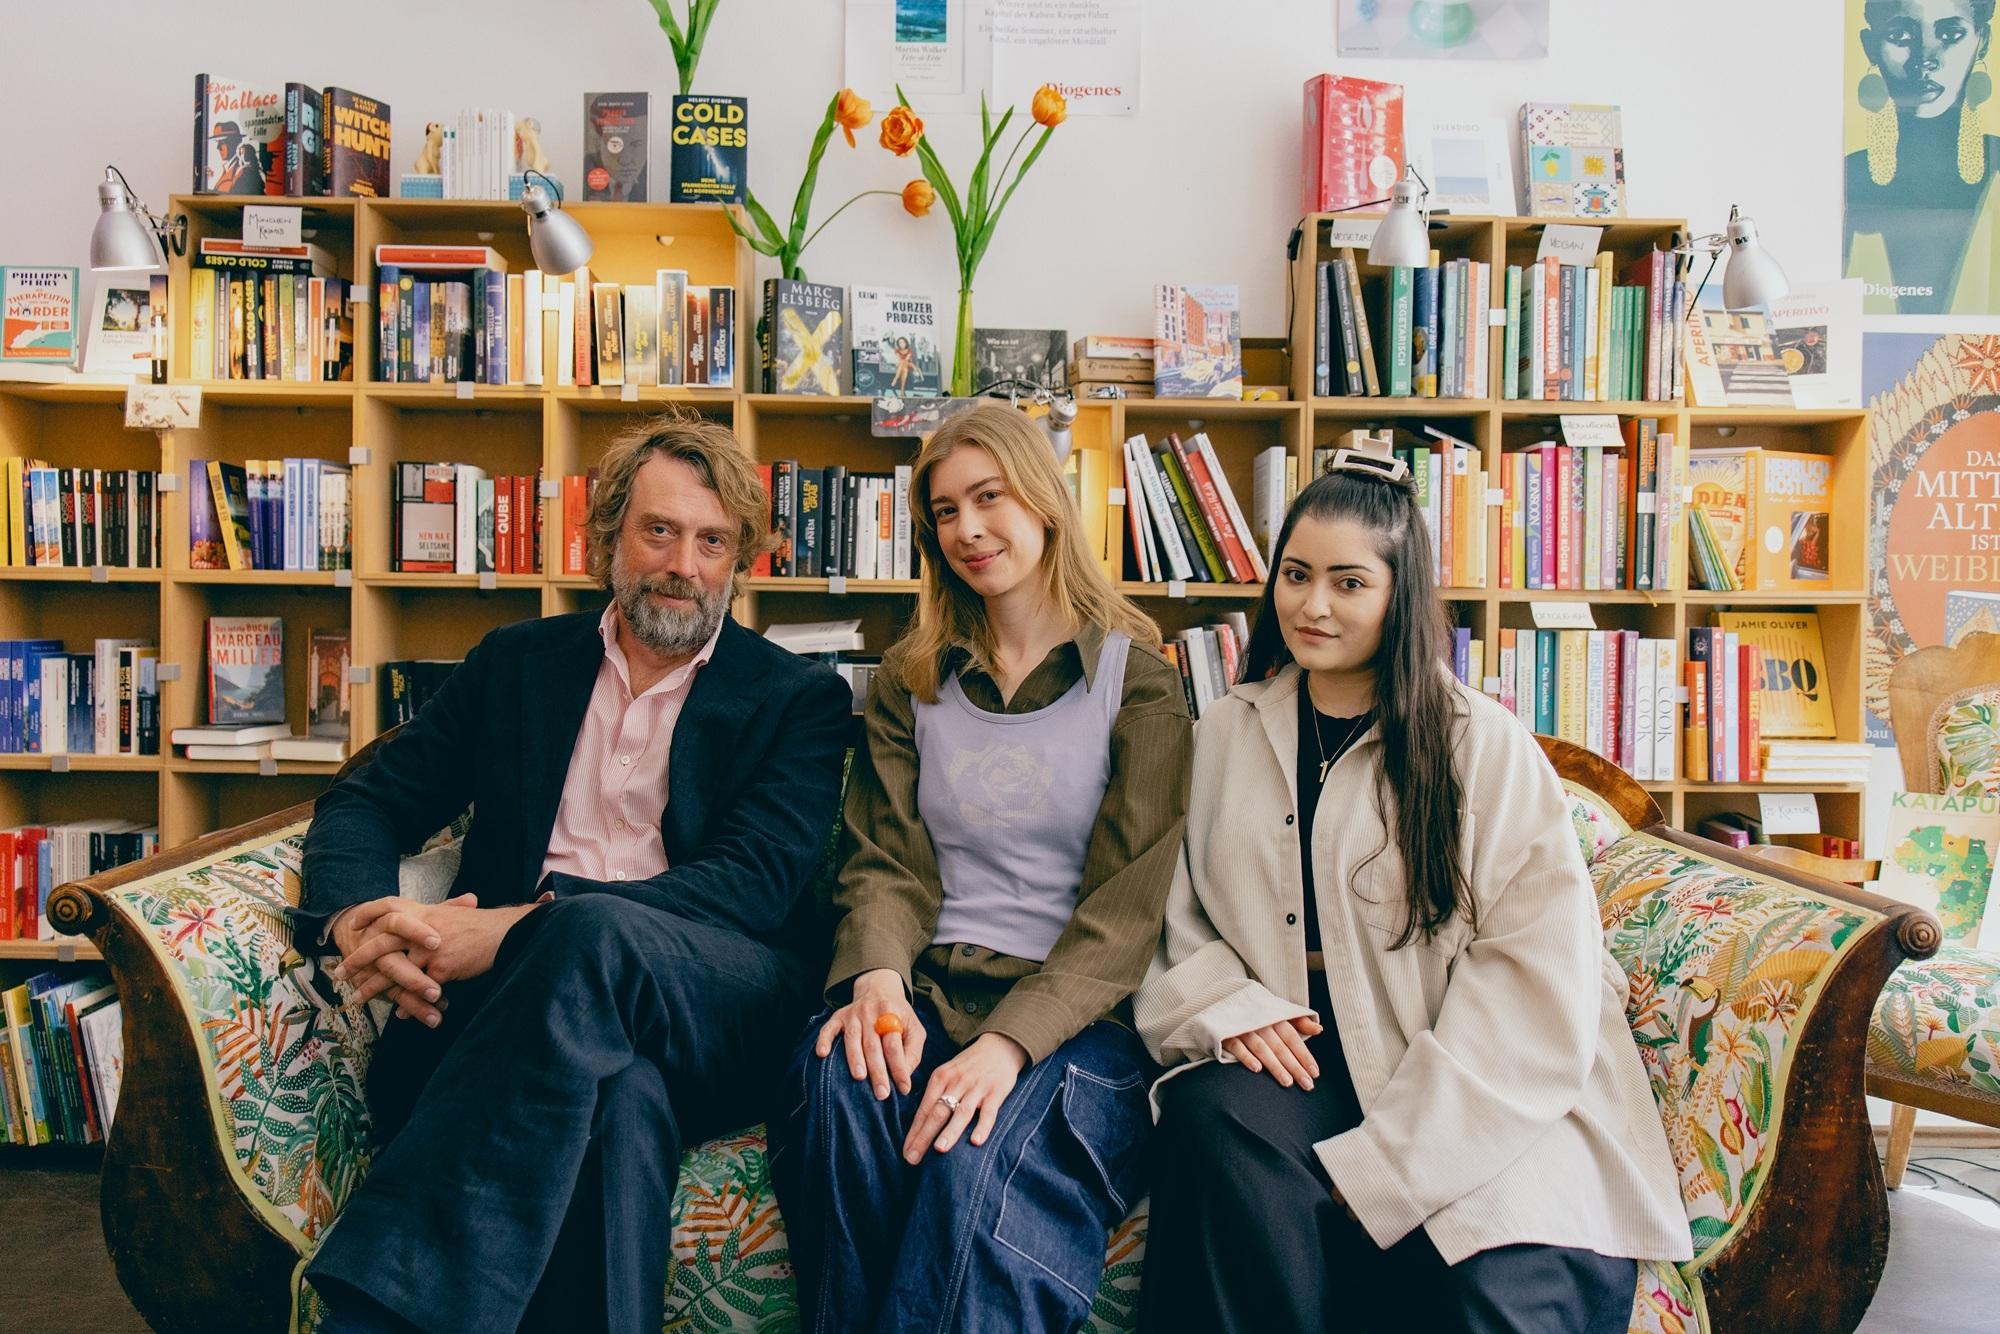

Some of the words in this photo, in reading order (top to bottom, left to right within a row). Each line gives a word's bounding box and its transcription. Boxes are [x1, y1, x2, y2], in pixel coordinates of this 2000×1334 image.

[205, 81, 236, 95] Edgar
[1045, 82, 1122, 98] Diogenes
[214, 90, 278, 114] Wallace
[255, 108, 265, 118] Die
[676, 103, 745, 124] COLD
[334, 105, 391, 139] WITCH
[334, 125, 391, 160] HUNT
[672, 125, 747, 148] CASES
[1550, 238, 1584, 250] VEGAN
[205, 256, 236, 266] CASES
[239, 259, 267, 268] COLD
[12, 272, 68, 280] PHILIPPA
[8, 291, 71, 305] THERAPEUTIN
[245, 280, 256, 311] CASES
[781, 292, 841, 311] ELSBERG
[791, 283, 833, 298] MARC
[1863, 283, 1933, 298] Diogenes
[886, 312, 934, 326] PROZESS
[892, 301, 933, 314] KURZER
[1772, 306, 1832, 320] APERITIVO
[247, 311, 256, 340] COLD
[1398, 296, 1407, 366] VEGETARISCH
[1429, 314, 1437, 333] CARB
[986, 337, 999, 346] Wie
[1640, 425, 1649, 487] JAPANISCHEN
[803, 480, 811, 513] WELLEN
[1150, 475, 1166, 514] Sapiens
[1529, 473, 1539, 525] MONSOON
[1618, 473, 1626, 503] WOCHE
[1560, 466, 1569, 536] KOREANISCHE
[498, 495, 509, 534] QUBE
[1927, 502, 2000, 530] ALT
[419, 532, 433, 540] HEN
[1605, 510, 1614, 554] AYURVEDA
[1617, 515, 1625, 556] PFLANZEN
[418, 542, 450, 550] SELTSAME
[428, 552, 450, 560] BILDER
[1560, 538, 1570, 573] KÜCHE
[246, 624, 269, 632] BUCH
[1735, 620, 1767, 630] JAMIE
[1769, 620, 1809, 630] OLIVER
[215, 633, 281, 647] MARCEAU
[216, 649, 282, 665] MILLER
[1589, 639, 1602, 688] JERUSALEM
[1504, 653, 1513, 696] Ottolenghi
[1608, 643, 1618, 706] OTTOLENGHI
[1626, 669, 1634, 706] Genussvoll
[1637, 685, 1653, 743] COOK
[1657, 686, 1673, 743] COOK
[1607, 710, 1617, 753] FLAVOUR
[1625, 707, 1634, 746] vegetarisch
[1892, 791, 2000, 815] KATAPU
